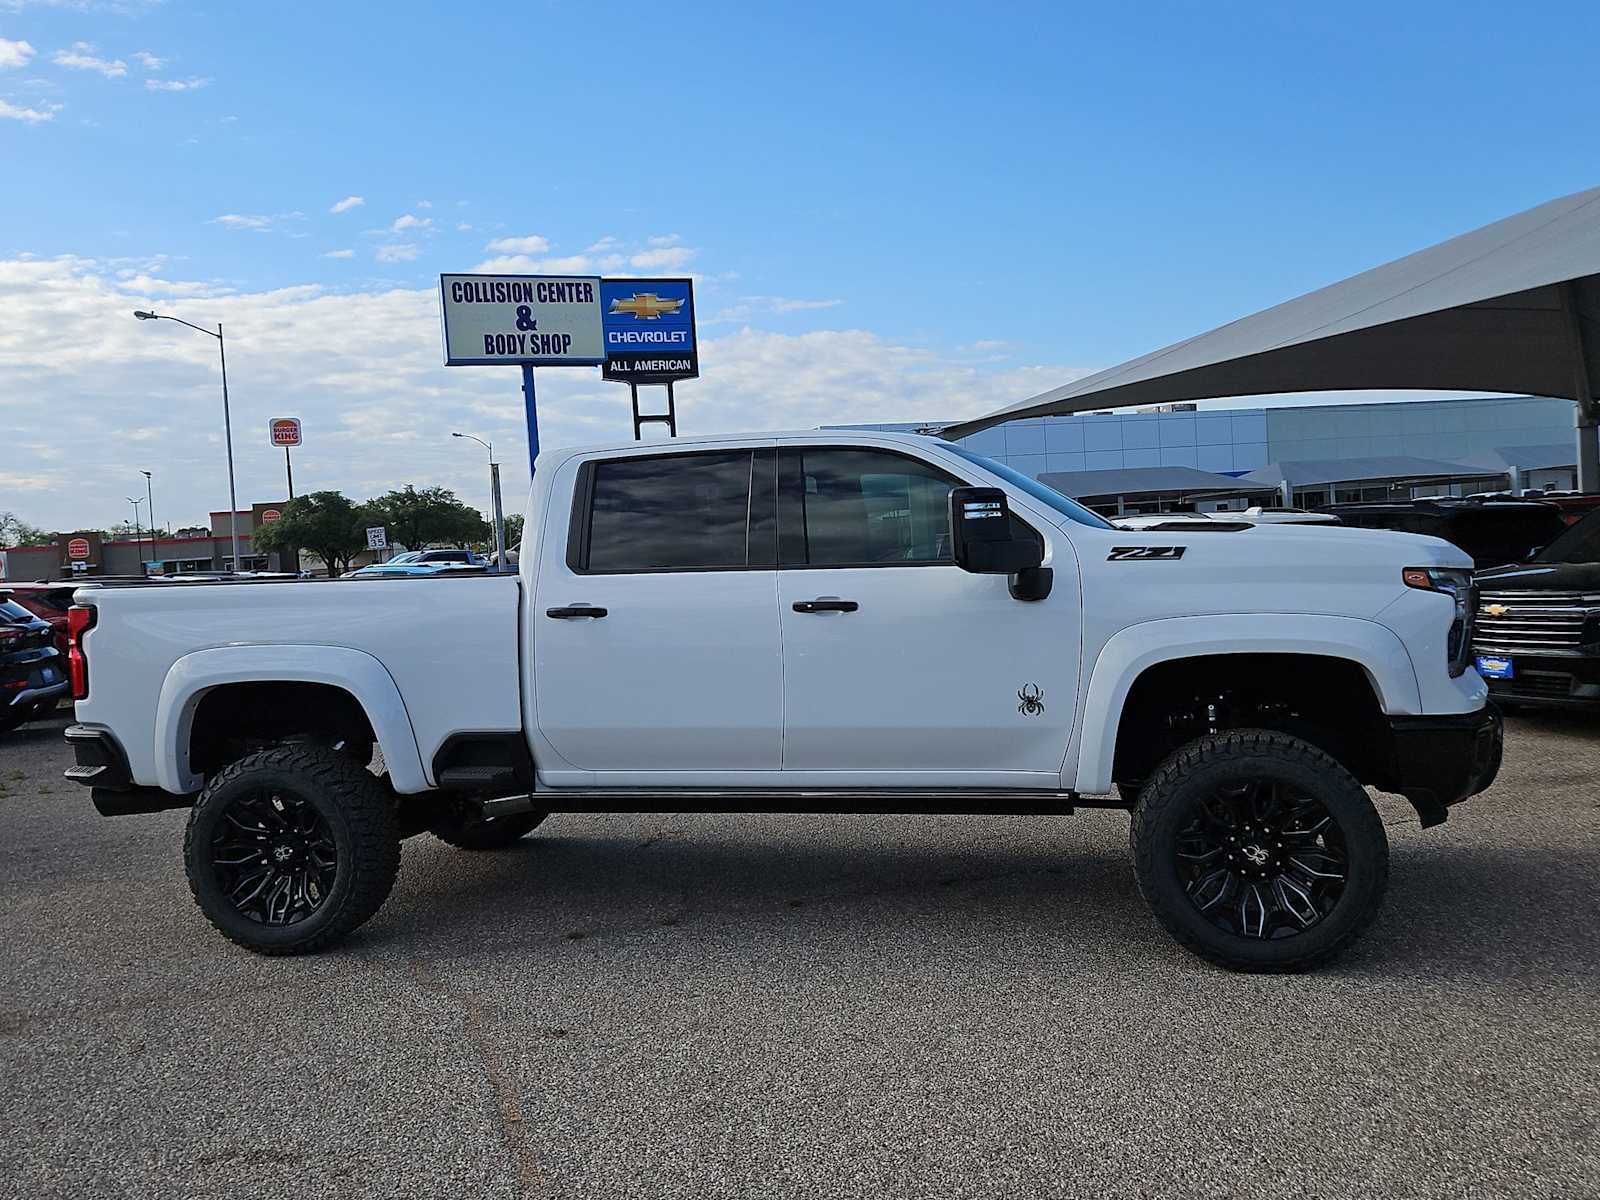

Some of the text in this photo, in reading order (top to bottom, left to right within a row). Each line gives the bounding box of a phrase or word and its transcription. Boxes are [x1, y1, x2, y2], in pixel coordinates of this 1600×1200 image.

[452, 281, 594, 303] COLLISION CENTER
[516, 305, 538, 332] &
[608, 331, 687, 343] CHEVROLET
[484, 334, 571, 355] BODY SHOP
[610, 360, 691, 371] ALL AMERICAN
[274, 432, 298, 440] KING
[370, 539, 385, 547] 35
